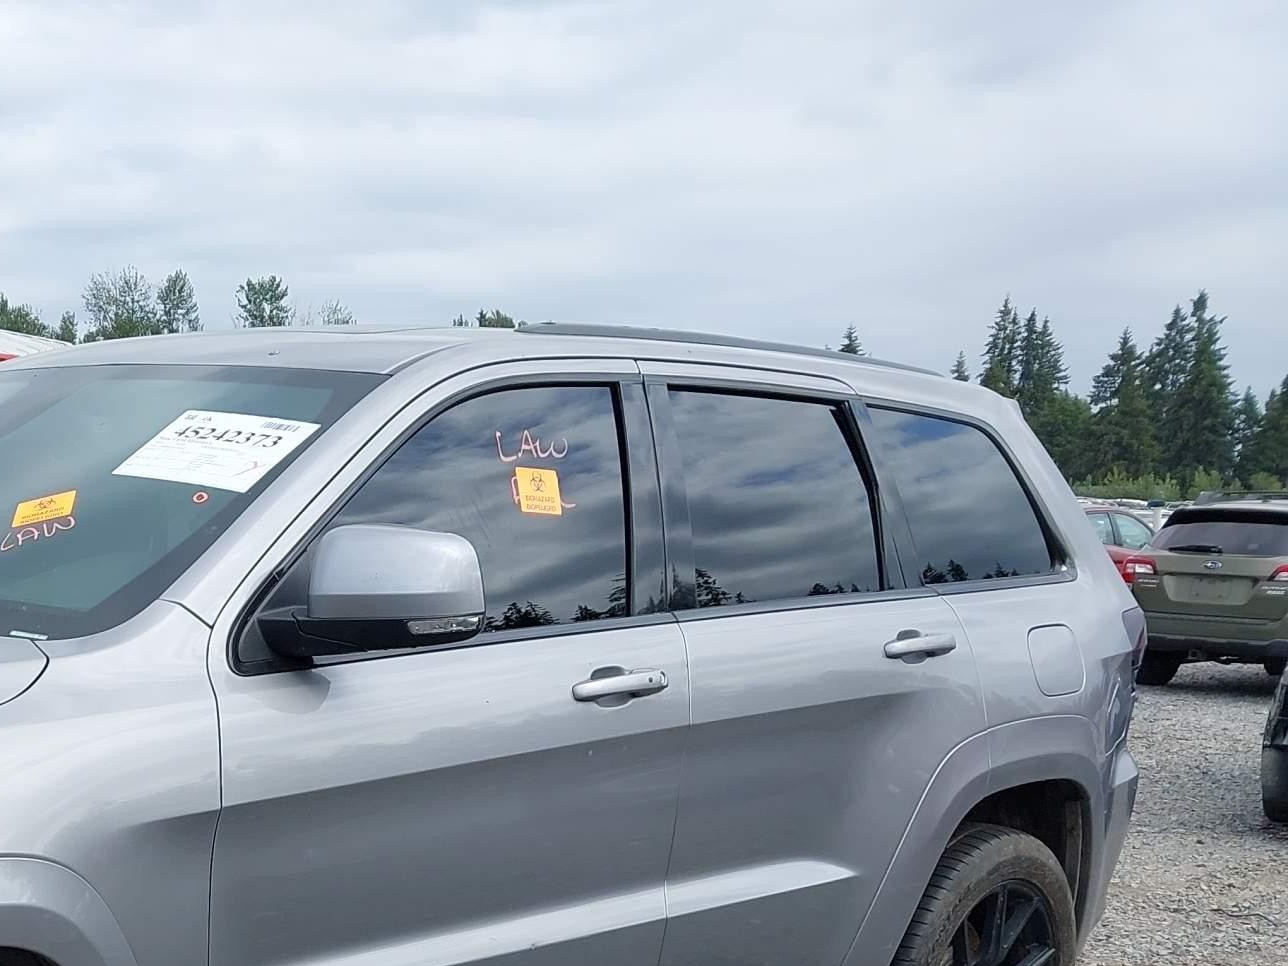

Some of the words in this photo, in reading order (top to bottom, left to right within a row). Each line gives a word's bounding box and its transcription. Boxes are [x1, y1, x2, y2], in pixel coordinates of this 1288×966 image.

[174, 425, 283, 448] 45242373
[495, 429, 569, 462] LAW
[0, 516, 76, 552] LAW
